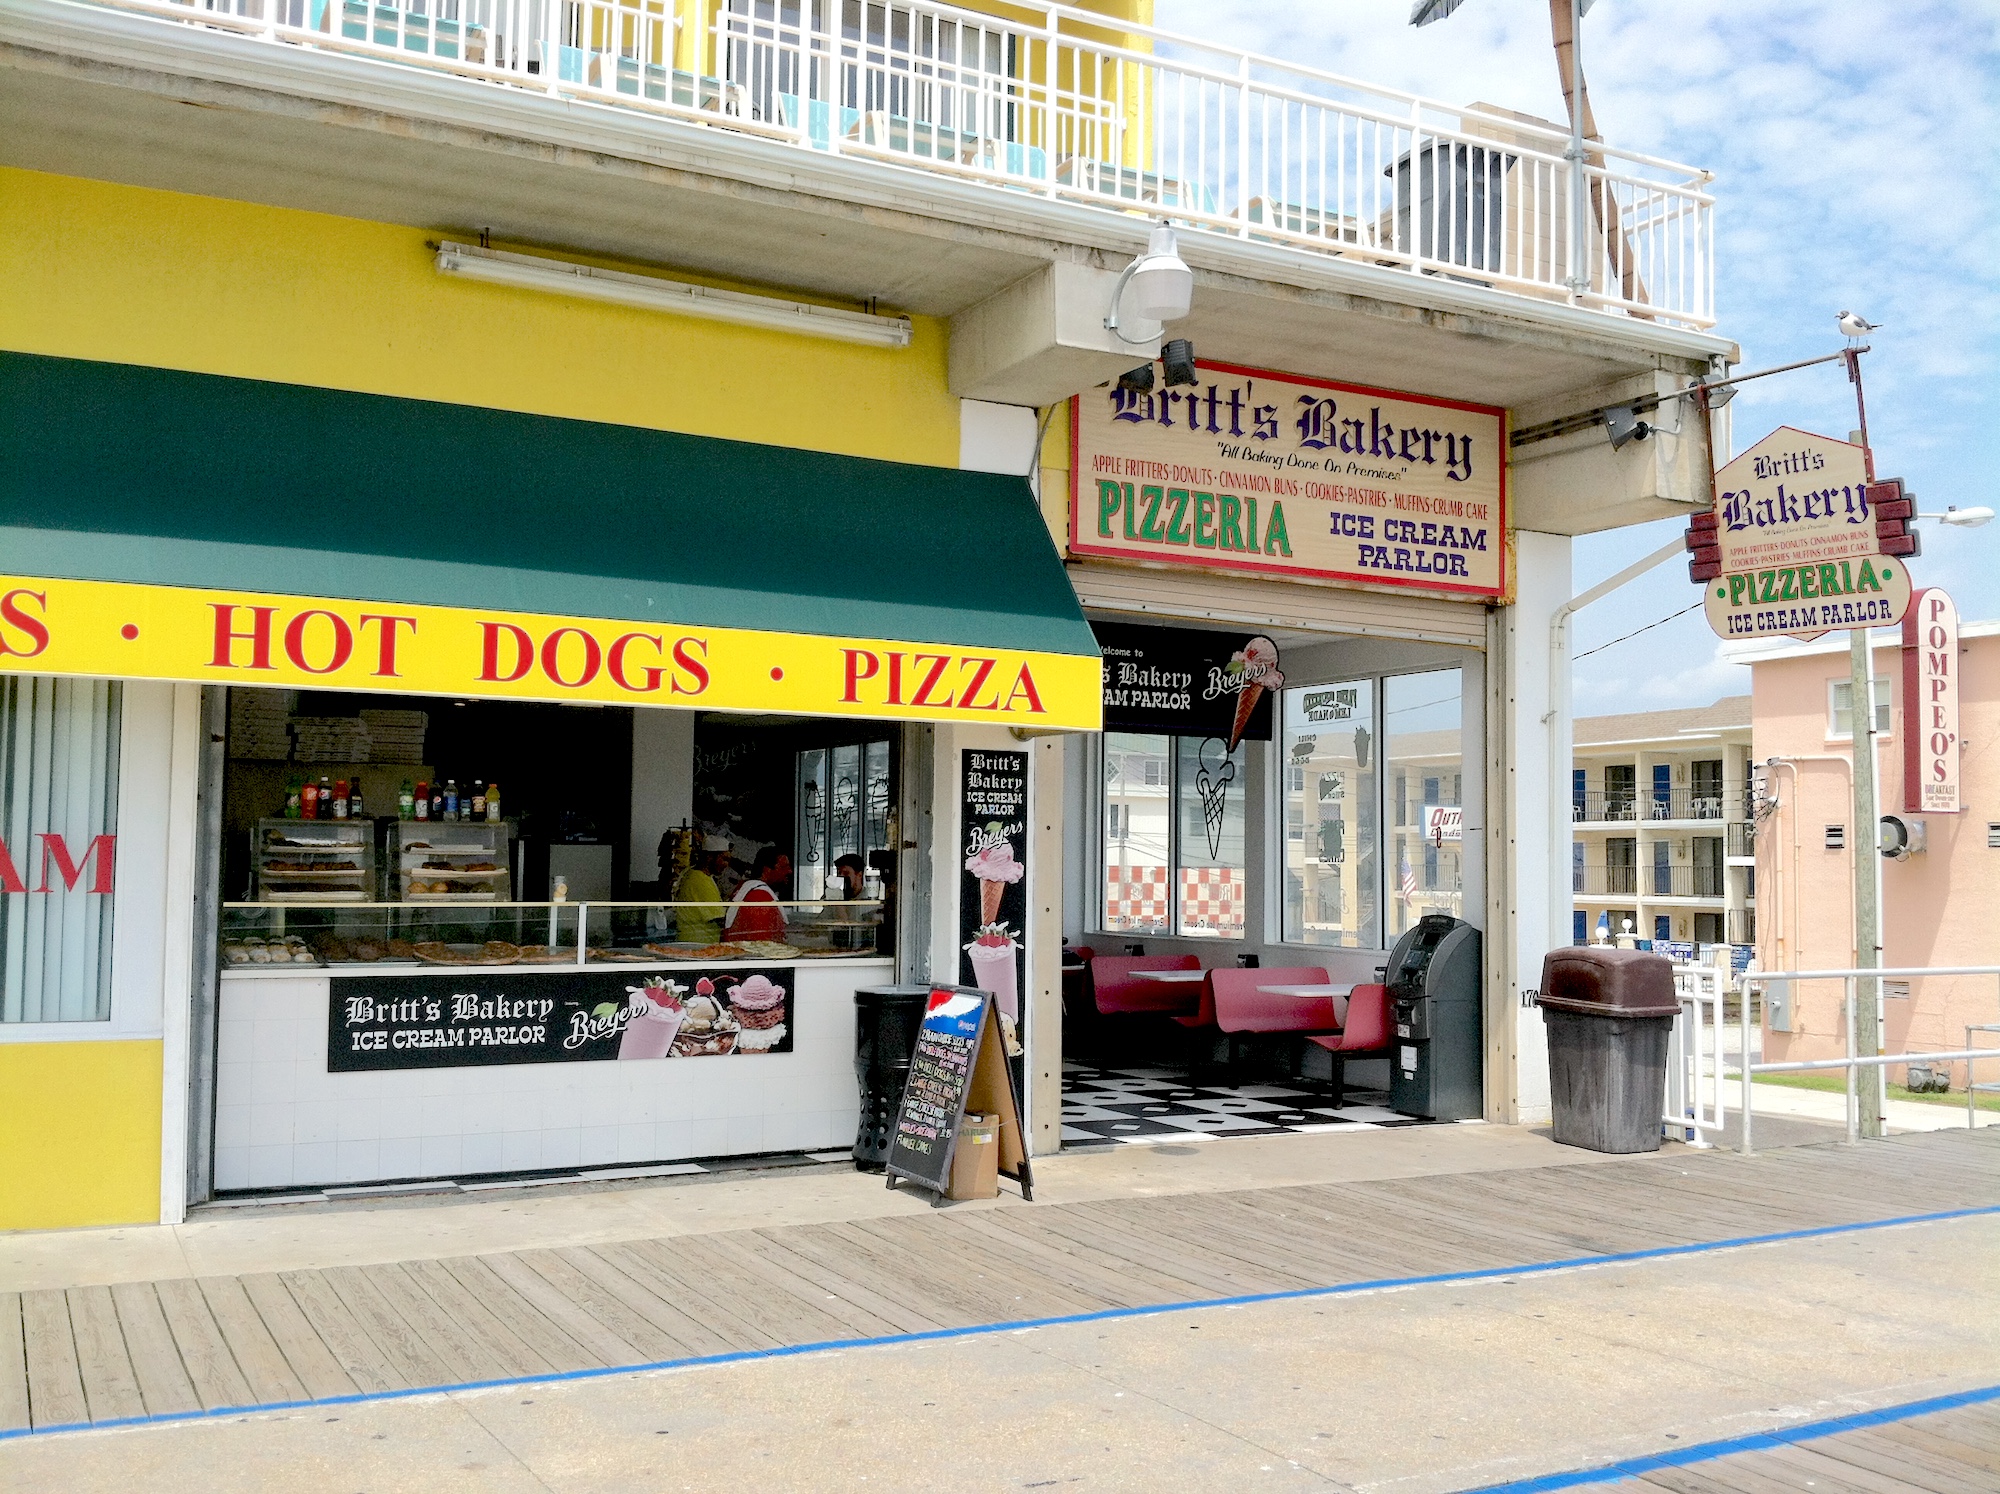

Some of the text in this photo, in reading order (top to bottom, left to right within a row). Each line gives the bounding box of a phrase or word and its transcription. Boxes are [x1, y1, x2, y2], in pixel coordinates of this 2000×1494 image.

[1297, 394, 1473, 481] Bakery
[1242, 446, 1283, 468] Baking
[1287, 452, 1319, 471] Done
[1325, 458, 1342, 473] On
[1754, 448, 1825, 479] Britt's
[1092, 455, 1121, 474] APPLE
[1173, 465, 1212, 486] DONUTS
[1219, 469, 1271, 492] CINNAMON
[1274, 478, 1298, 496] BUNS
[1305, 481, 1344, 501] COOKIES
[1433, 498, 1463, 517] CRUMB
[1466, 501, 1488, 520] CAKE
[1095, 478, 1293, 558] PIZZERIA
[1721, 483, 1869, 532] Bakery
[1330, 512, 1487, 551] ICE CREAM
[1850, 541, 1870, 552] CAKE
[1357, 544, 1468, 577] PARLOR
[1726, 558, 1883, 606] PIZZERIA
[1728, 599, 1892, 634] ICE CREAM PARLOR
[204, 602, 417, 677] HOT
[474, 620, 710, 695] DOGS
[838, 648, 1047, 713] PIZZA
[1134, 648, 1144, 658] to
[1118, 662, 1192, 693] Bakery
[1203, 663, 1267, 700] Breyers
[1927, 598, 1955, 783] POMPEO'S
[1131, 690, 1191, 710] PARLOR
[971, 752, 1020, 772] Britt's
[967, 772, 1023, 792] Bakery
[967, 791, 1023, 804] ICE CREAM
[975, 804, 1015, 816] PARLOR
[966, 820, 1023, 856] Breyers
[345, 992, 554, 1027] Britt's Bakery
[563, 1000, 648, 1049] Breyers
[352, 1025, 545, 1051] ICE CREAM PARLOR
